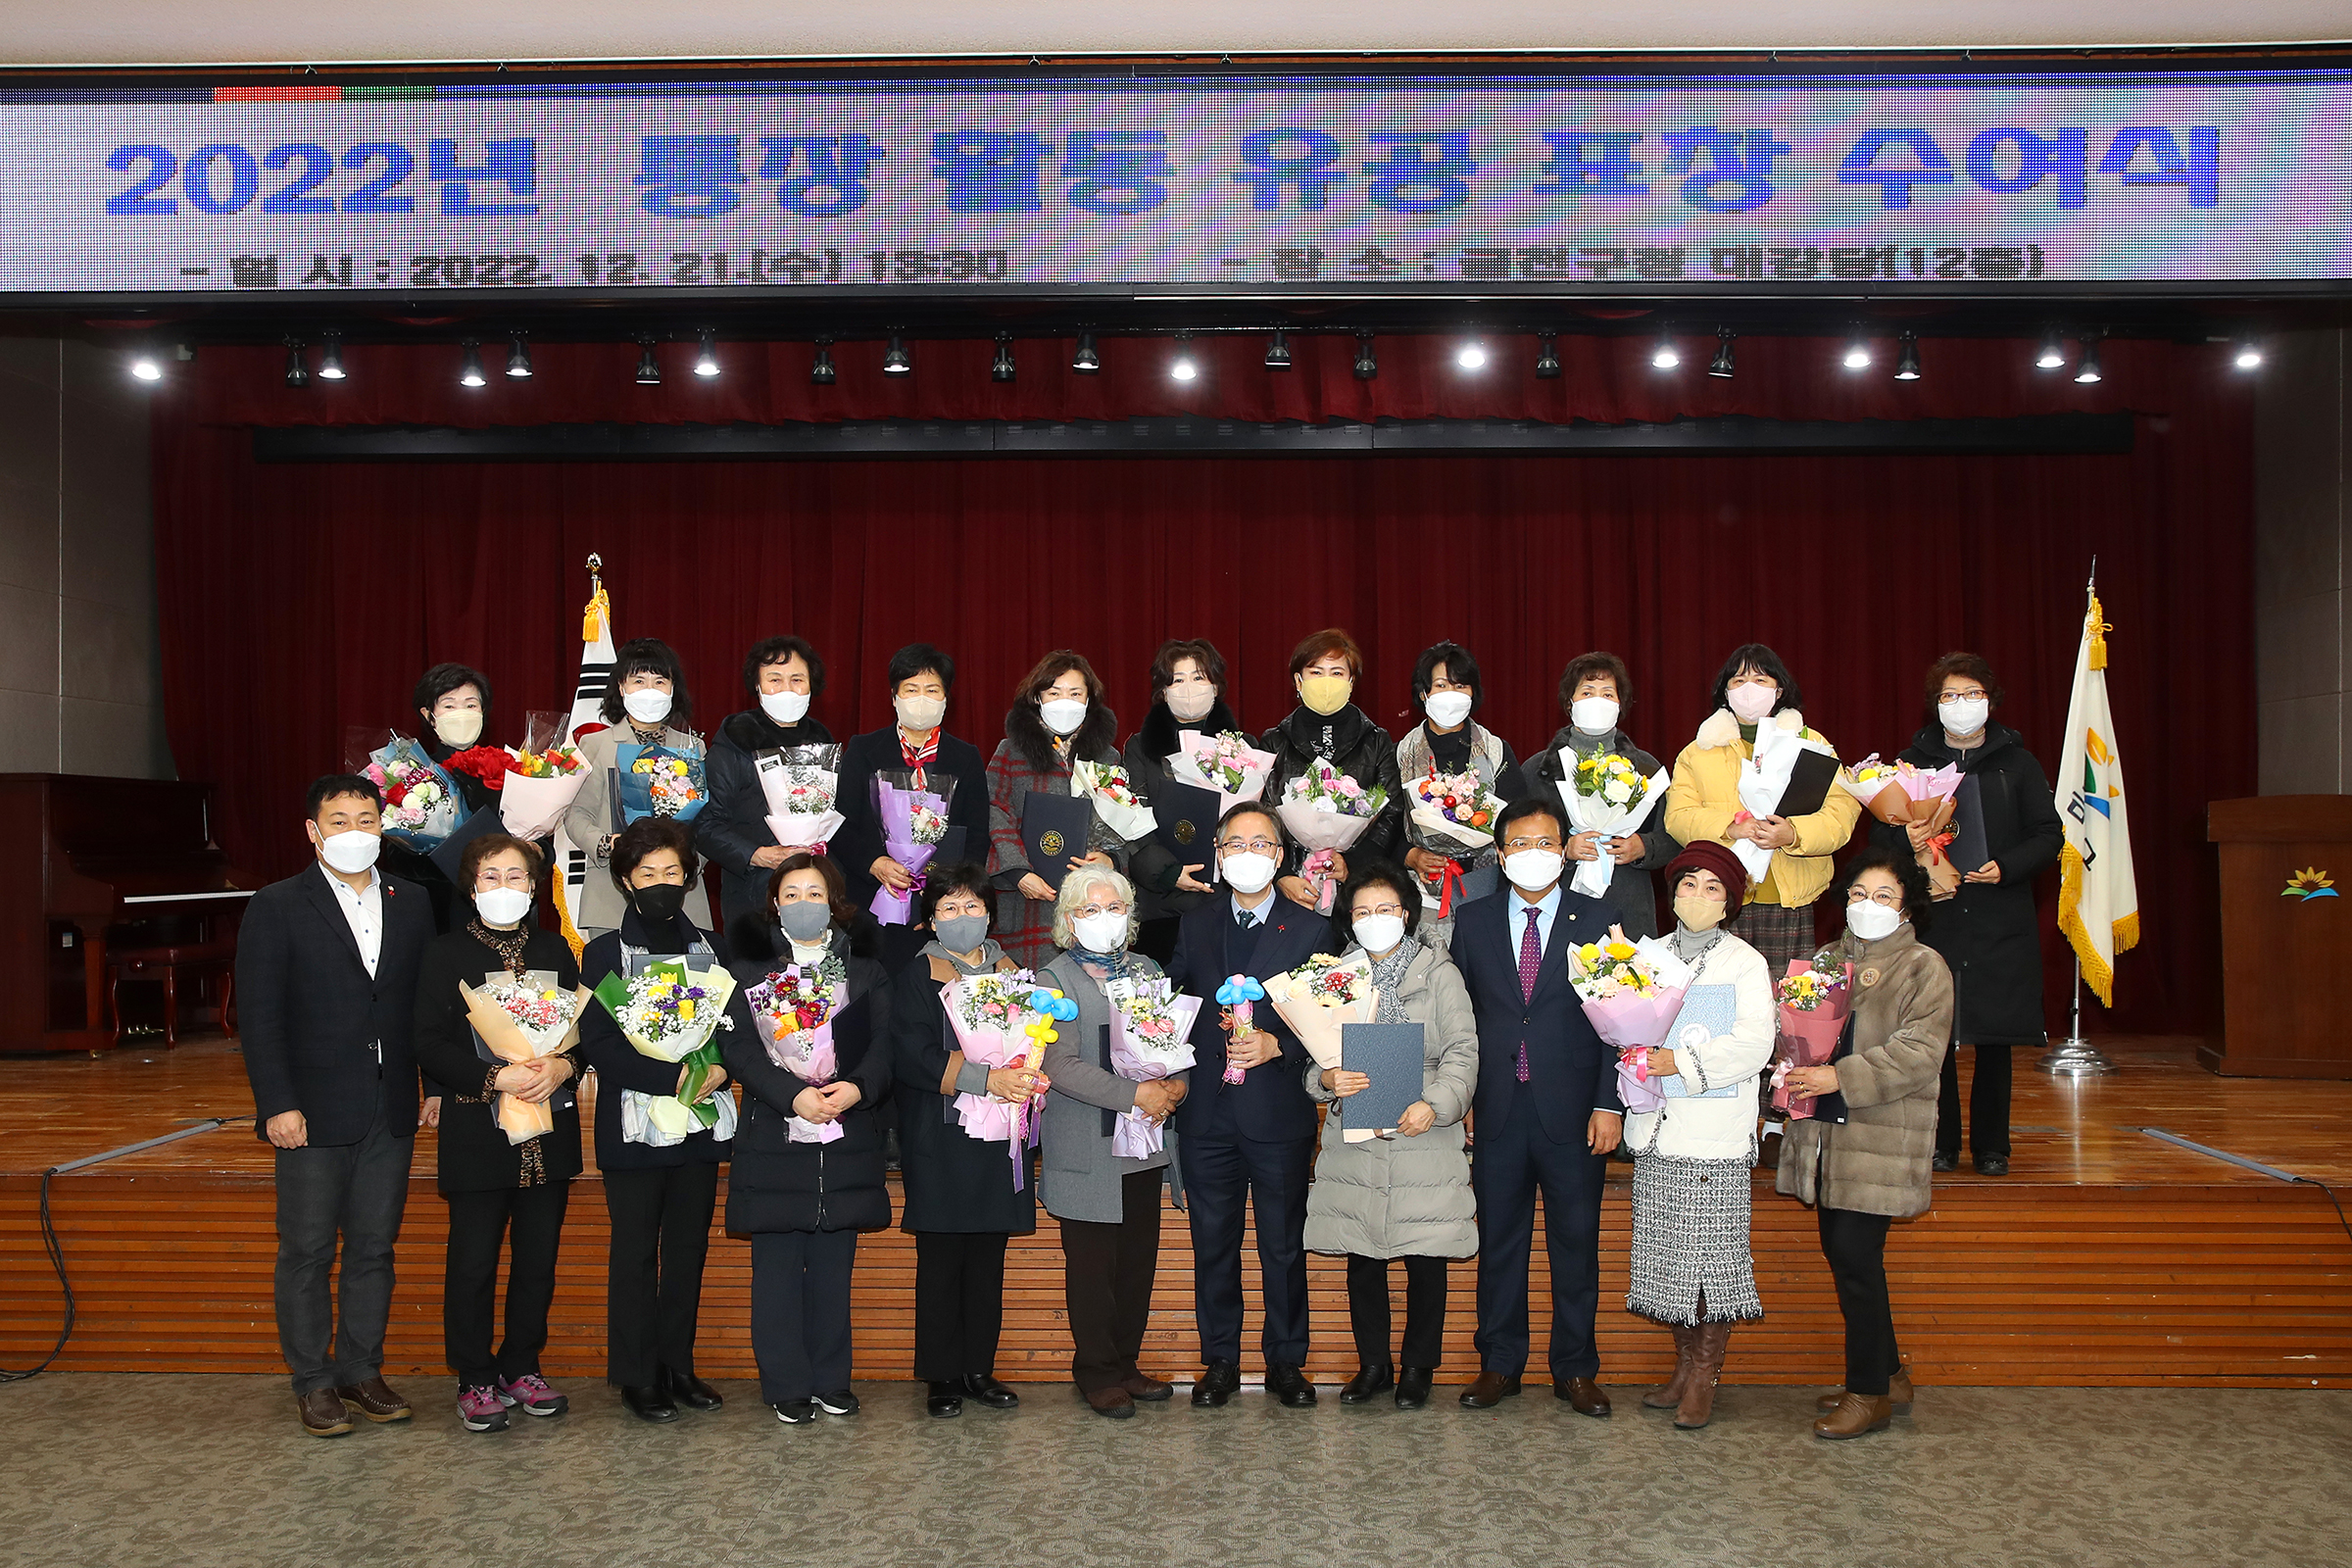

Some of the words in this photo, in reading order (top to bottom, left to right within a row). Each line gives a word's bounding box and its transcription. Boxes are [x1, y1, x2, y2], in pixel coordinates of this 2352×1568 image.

[104, 137, 540, 218] 2022년
[930, 128, 1177, 216] 활동
[1231, 126, 1478, 215] 유공
[1533, 125, 1792, 214] 표창
[1836, 124, 2221, 211] 수여식
[410, 254, 553, 286] 2022.
[575, 252, 651, 284] 12.
[865, 249, 1009, 281] 13:30
